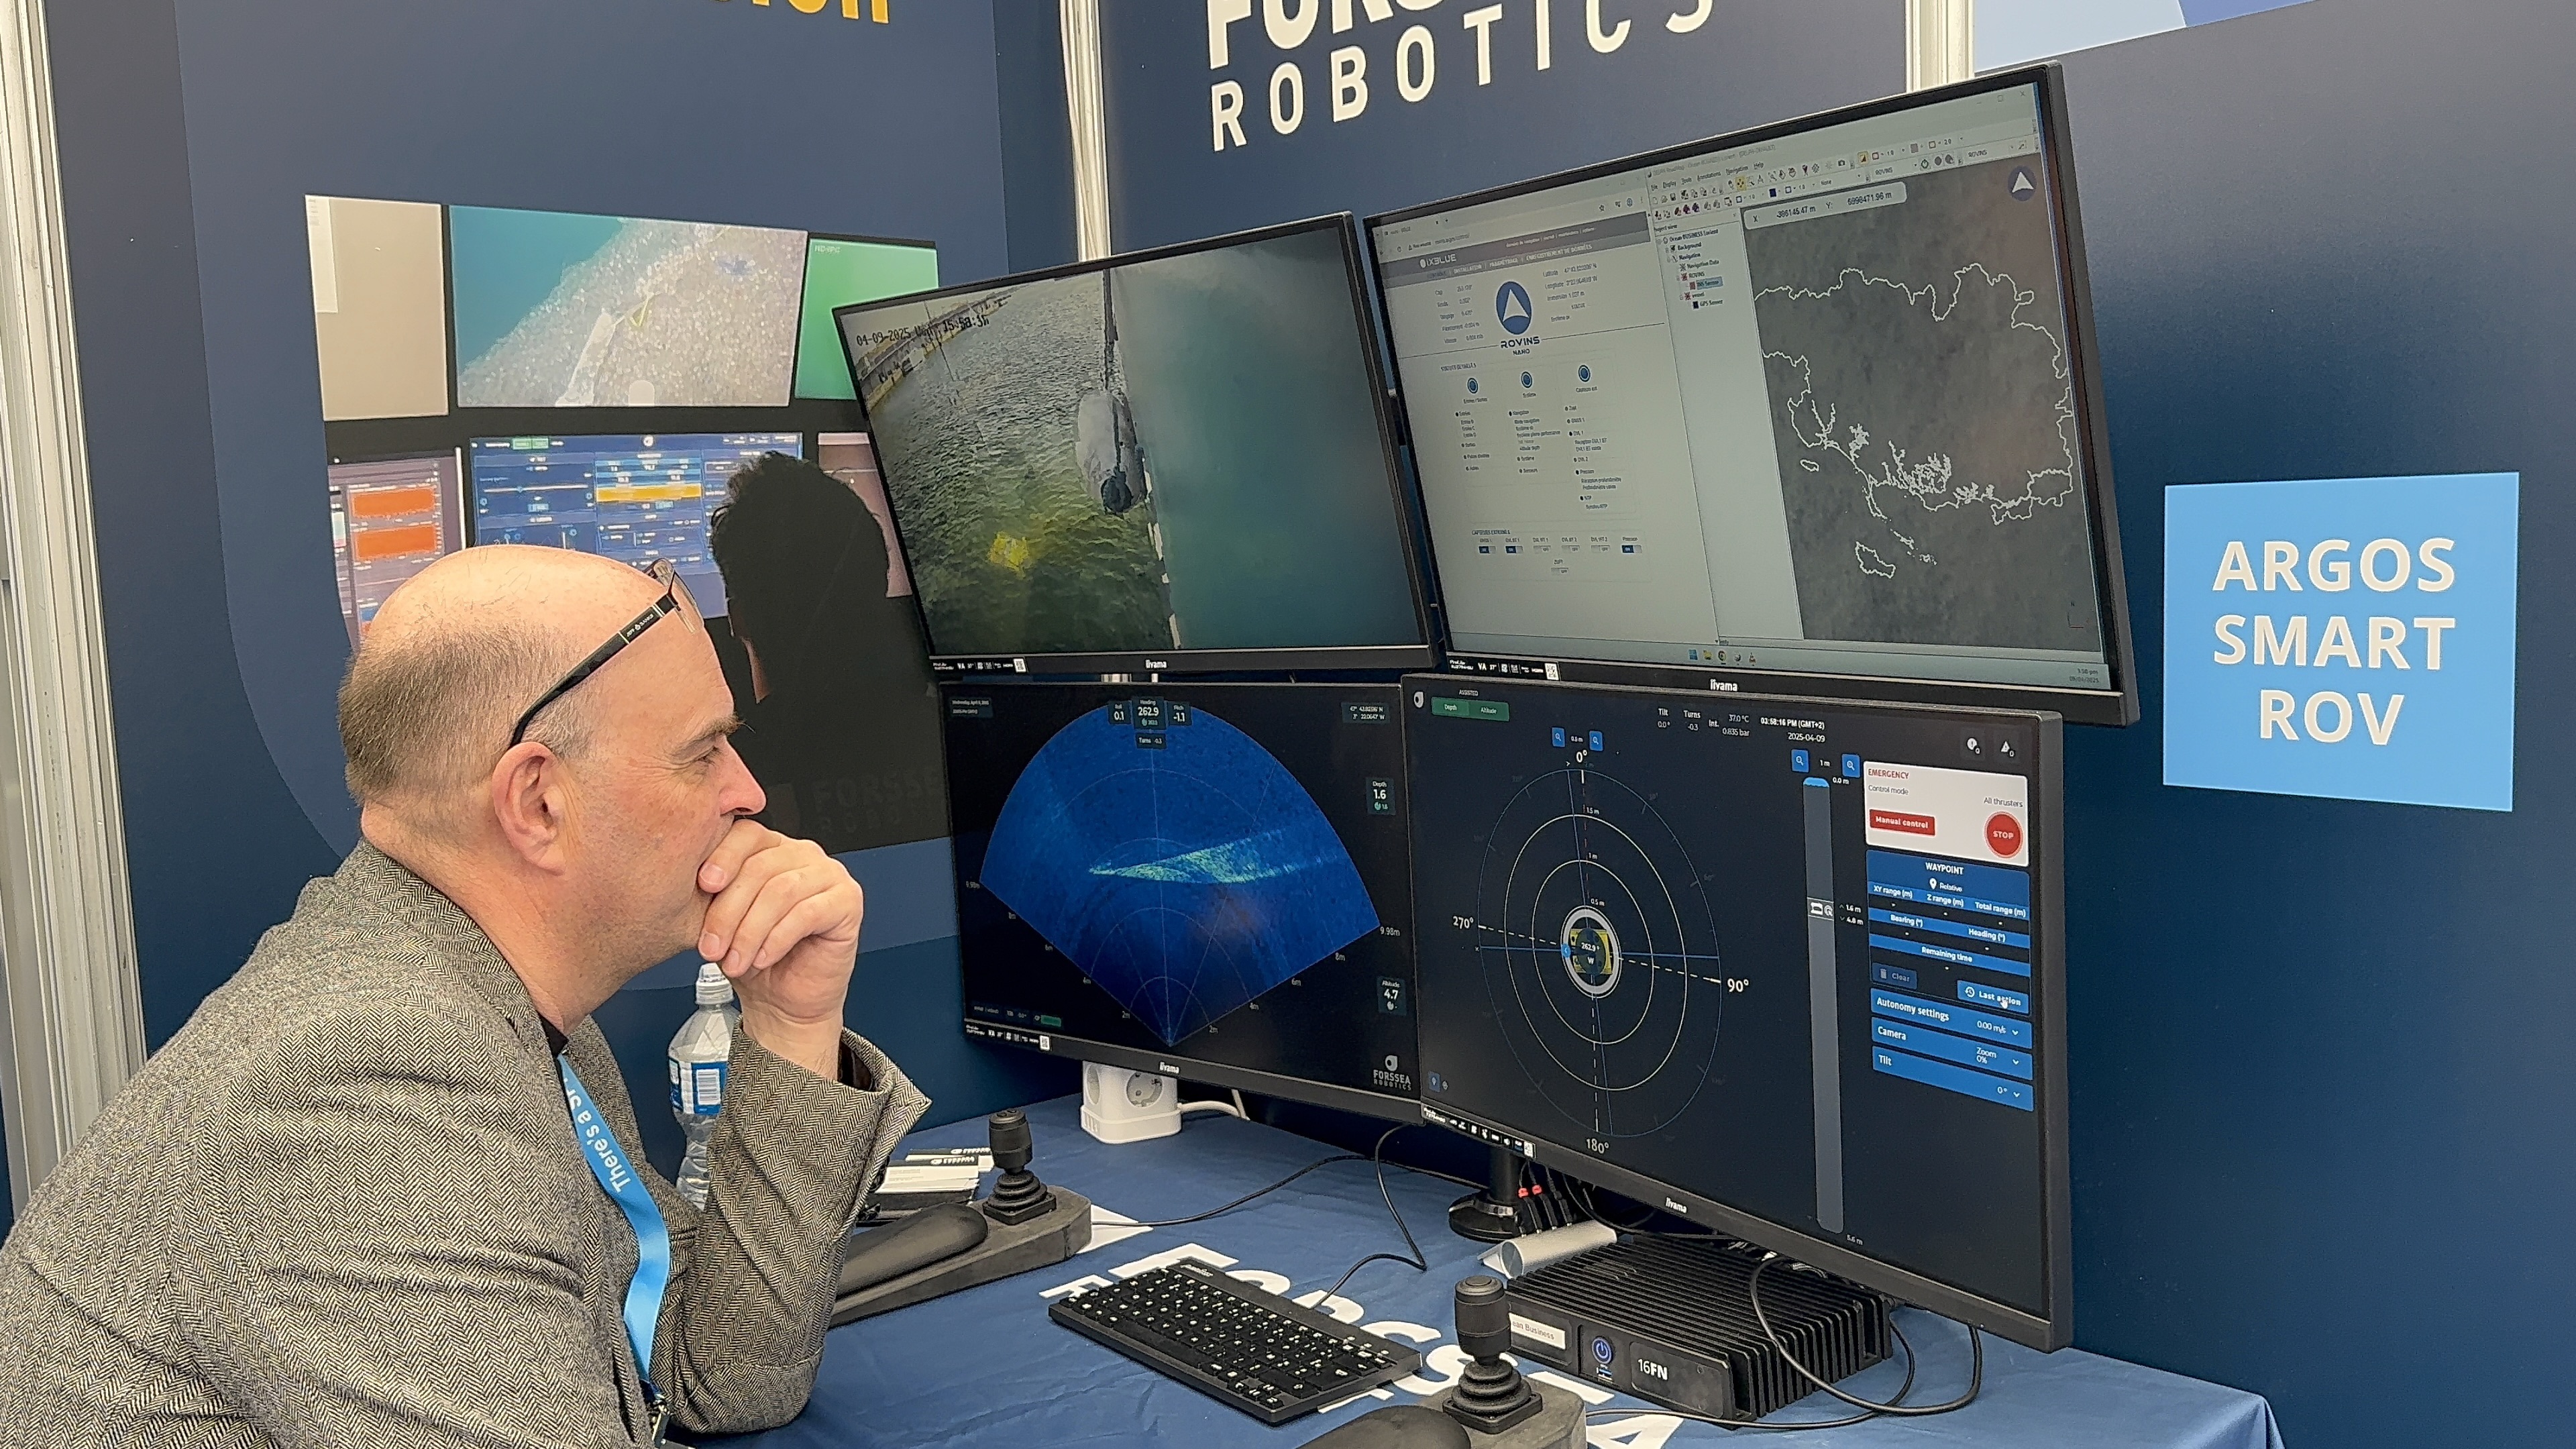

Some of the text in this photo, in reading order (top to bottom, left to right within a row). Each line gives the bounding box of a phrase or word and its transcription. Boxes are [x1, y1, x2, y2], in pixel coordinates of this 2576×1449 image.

[1501, 336, 1540, 349] ROVINS
[2212, 538, 2456, 592] ARGOS
[2214, 614, 2456, 670] SMART
[1709, 678, 1738, 692] iiyama
[1137, 706, 1159, 716] 262.9
[1444, 703, 1497, 715] Depth Altitude
[1658, 708, 1669, 716] Tilt
[1683, 710, 1701, 719] Turns
[1114, 711, 1124, 721] 0.1
[1173, 712, 1185, 722] -1.1
[1728, 714, 1741, 722] 37.0
[2260, 689, 2405, 745] ROV
[1687, 723, 1699, 731] -0.3
[1709, 719, 1720, 728] Int.
[1786, 719, 1798, 729] PM
[1798, 719, 1825, 731] (GMT+2)
[1722, 727, 1750, 737] 0.835 bar
[1787, 731, 1826, 743] 2025-04-09
[1576, 749, 1587, 763] 0°
[1832, 776, 1842, 784] 0.0
[1868, 768, 1910, 780] EMERGENCY
[1373, 789, 1387, 800] 1.6
[1868, 784, 1909, 796] Control mode
[1984, 797, 2023, 808] All thrusters
[1875, 816, 1929, 829] Manual control
[1992, 829, 2015, 840] STOP
[1925, 862, 1964, 875] WAYPOINT
[1873, 885, 1913, 900] XY range (m)
[1939, 882, 1963, 892] Relative
[1932, 896, 1952, 906] range
[1953, 898, 1964, 908] (m)
[1975, 902, 2027, 918] Total range (m)
[1452, 916, 1474, 930] 270°
[1890, 914, 1915, 926] Bearing
[1380, 926, 1401, 936] 9.98m
[1968, 928, 1997, 941] Heading
[1335, 952, 1345, 961] 8m
[1921, 946, 1973, 963] Remaining time
[1587, 957, 1594, 965] W
[1291, 977, 1301, 987] 6m
[1892, 972, 1910, 983] Clear
[1727, 978, 1750, 993] 90°
[1384, 988, 1399, 1000] 4.7
[1978, 990, 1995, 1002] Last
[1876, 996, 2006, 1034] Autonomy settings 0.00 m/s
[1209, 1025, 1219, 1034] 2m
[1878, 1026, 1907, 1041] Camera
[1976, 1046, 1997, 1059] Zoom
[1878, 1054, 1892, 1067] Tilt
[1976, 1055, 1988, 1065] 0%
[1373, 1069, 1411, 1085] FORSSEA
[1373, 1078, 1412, 1091] ROBOTICS
[577, 1109, 631, 1193] There's a
[1586, 1137, 1609, 1155] 180°
[1512, 1320, 1555, 1340] ean Business
[1638, 1358, 1669, 1381] 16FN
